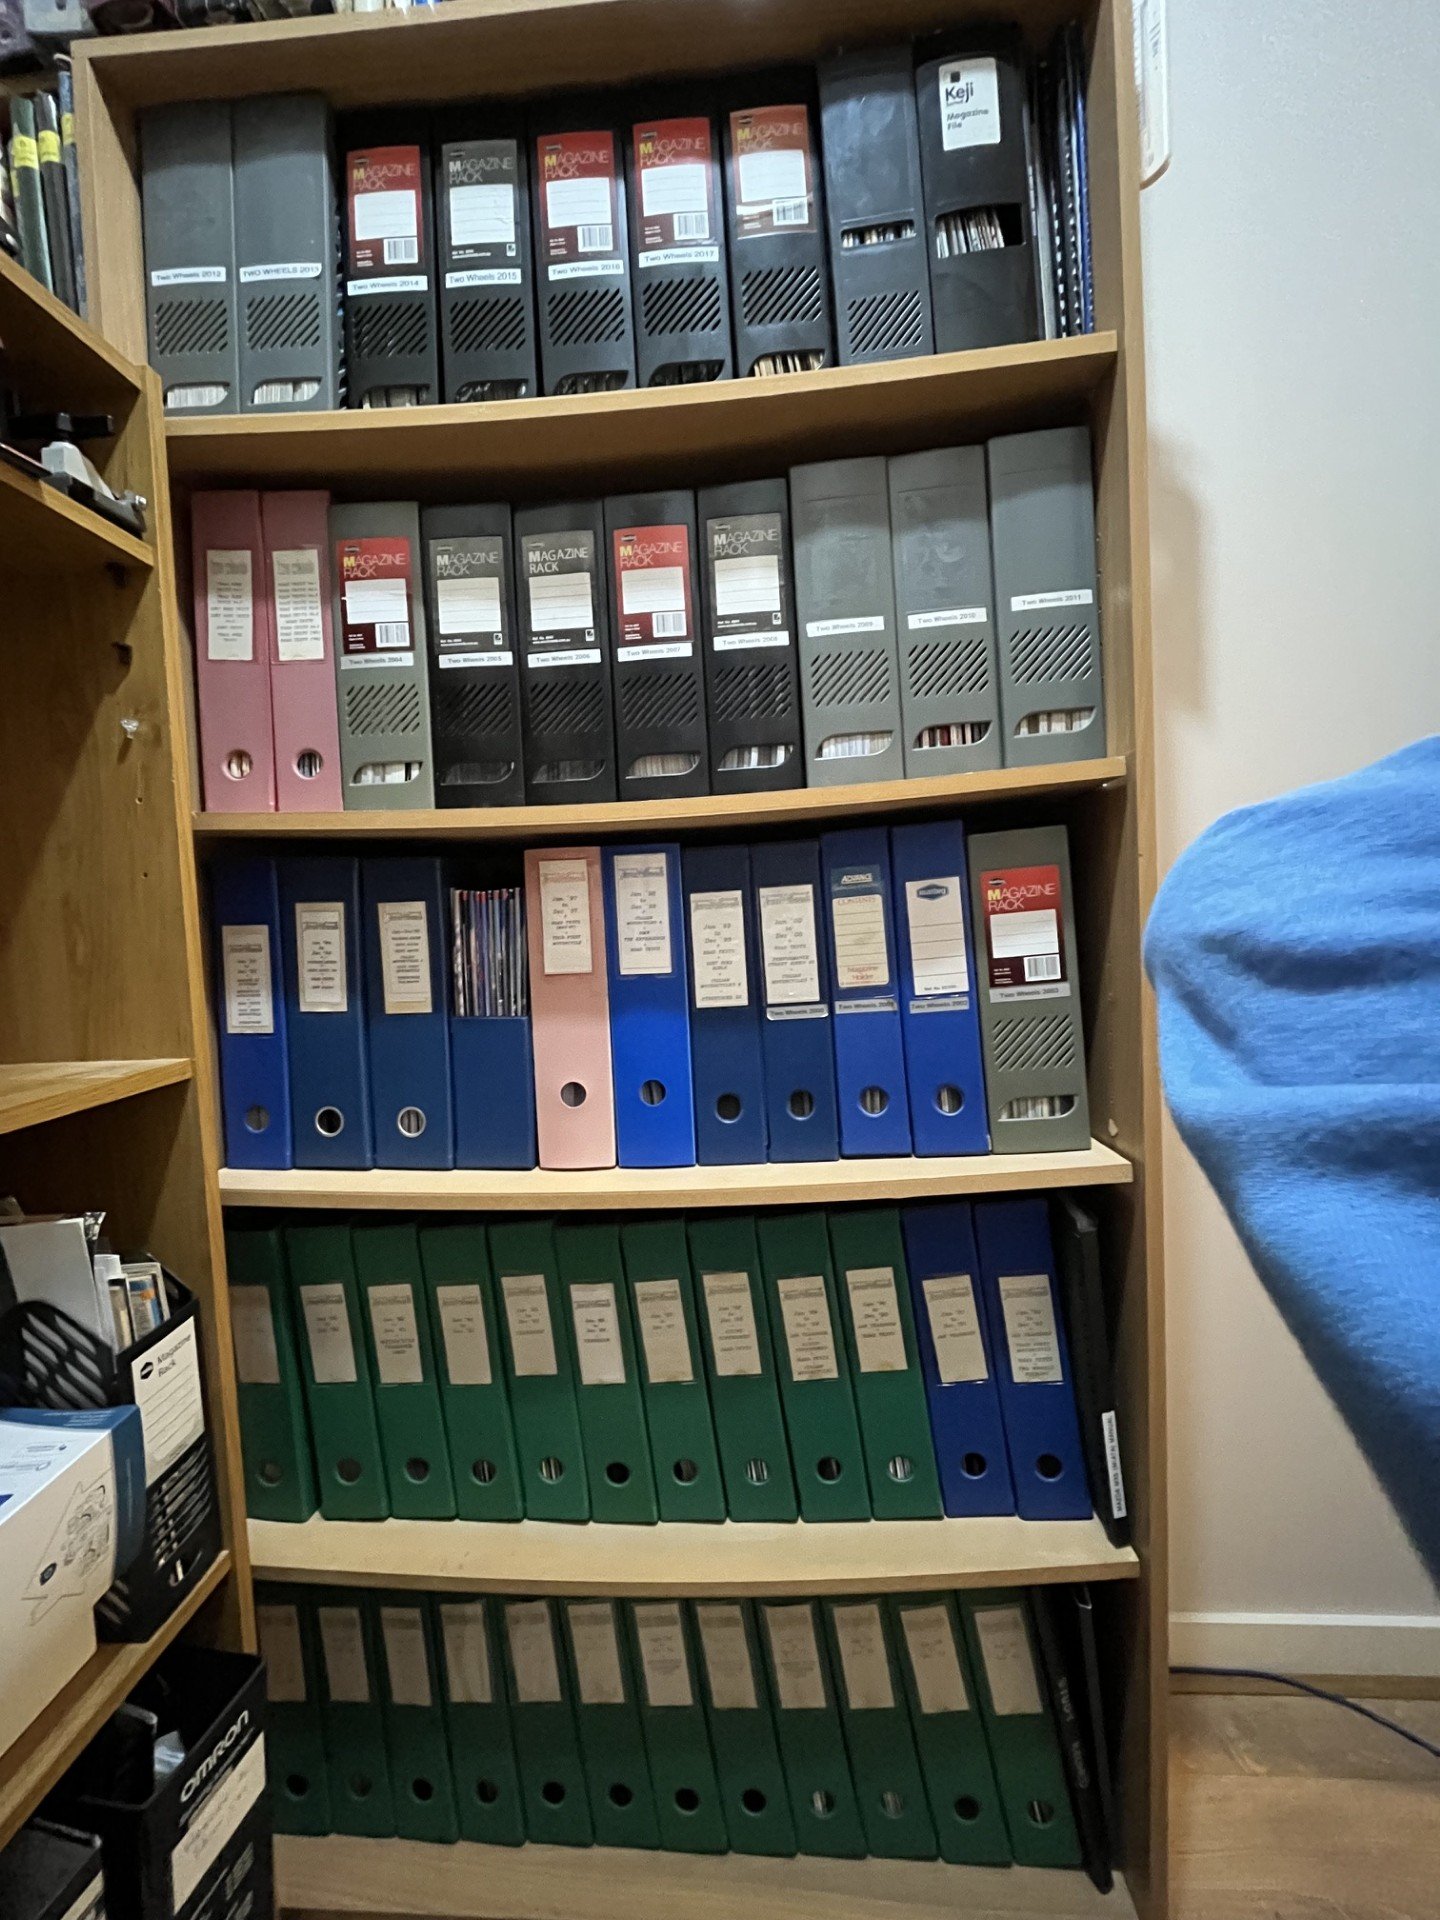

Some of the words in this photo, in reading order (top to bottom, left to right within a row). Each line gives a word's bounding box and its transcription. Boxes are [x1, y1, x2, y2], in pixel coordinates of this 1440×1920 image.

[946, 82, 973, 103] Keji
[947, 109, 989, 121] Magazine
[948, 122, 962, 130] File
[639, 137, 705, 154] MAGAZINE
[449, 157, 513, 172] MAGAZINE
[544, 150, 609, 167] MAGAZINE
[353, 163, 416, 179] MAGAZINE
[644, 255, 661, 263] Two
[663, 252, 693, 260] Wheels
[694, 250, 715, 258] 2017
[243, 270, 262, 278] TWO
[263, 267, 298, 275] WHEELS
[552, 268, 568, 276] Two
[570, 266, 599, 274] Wheels
[600, 263, 621, 271] 2016
[449, 276, 465, 284] Two
[466, 273, 495, 282] Wheels
[497, 271, 517, 281] 2015
[714, 528, 779, 545] MAGAZINE
[528, 547, 589, 563] MAGAZINE
[619, 541, 682, 556] MAGAZINE
[343, 553, 408, 567] MAGAZINE
[437, 552, 499, 566] MAGAZINE
[529, 562, 559, 574] RACK
[842, 873, 873, 884] ADVANCE
[987, 883, 1056, 900] MAGAZINE
[988, 898, 1025, 912] RACK
[157, 1334, 191, 1366] Magazine
[158, 1359, 176, 1378] Rack
